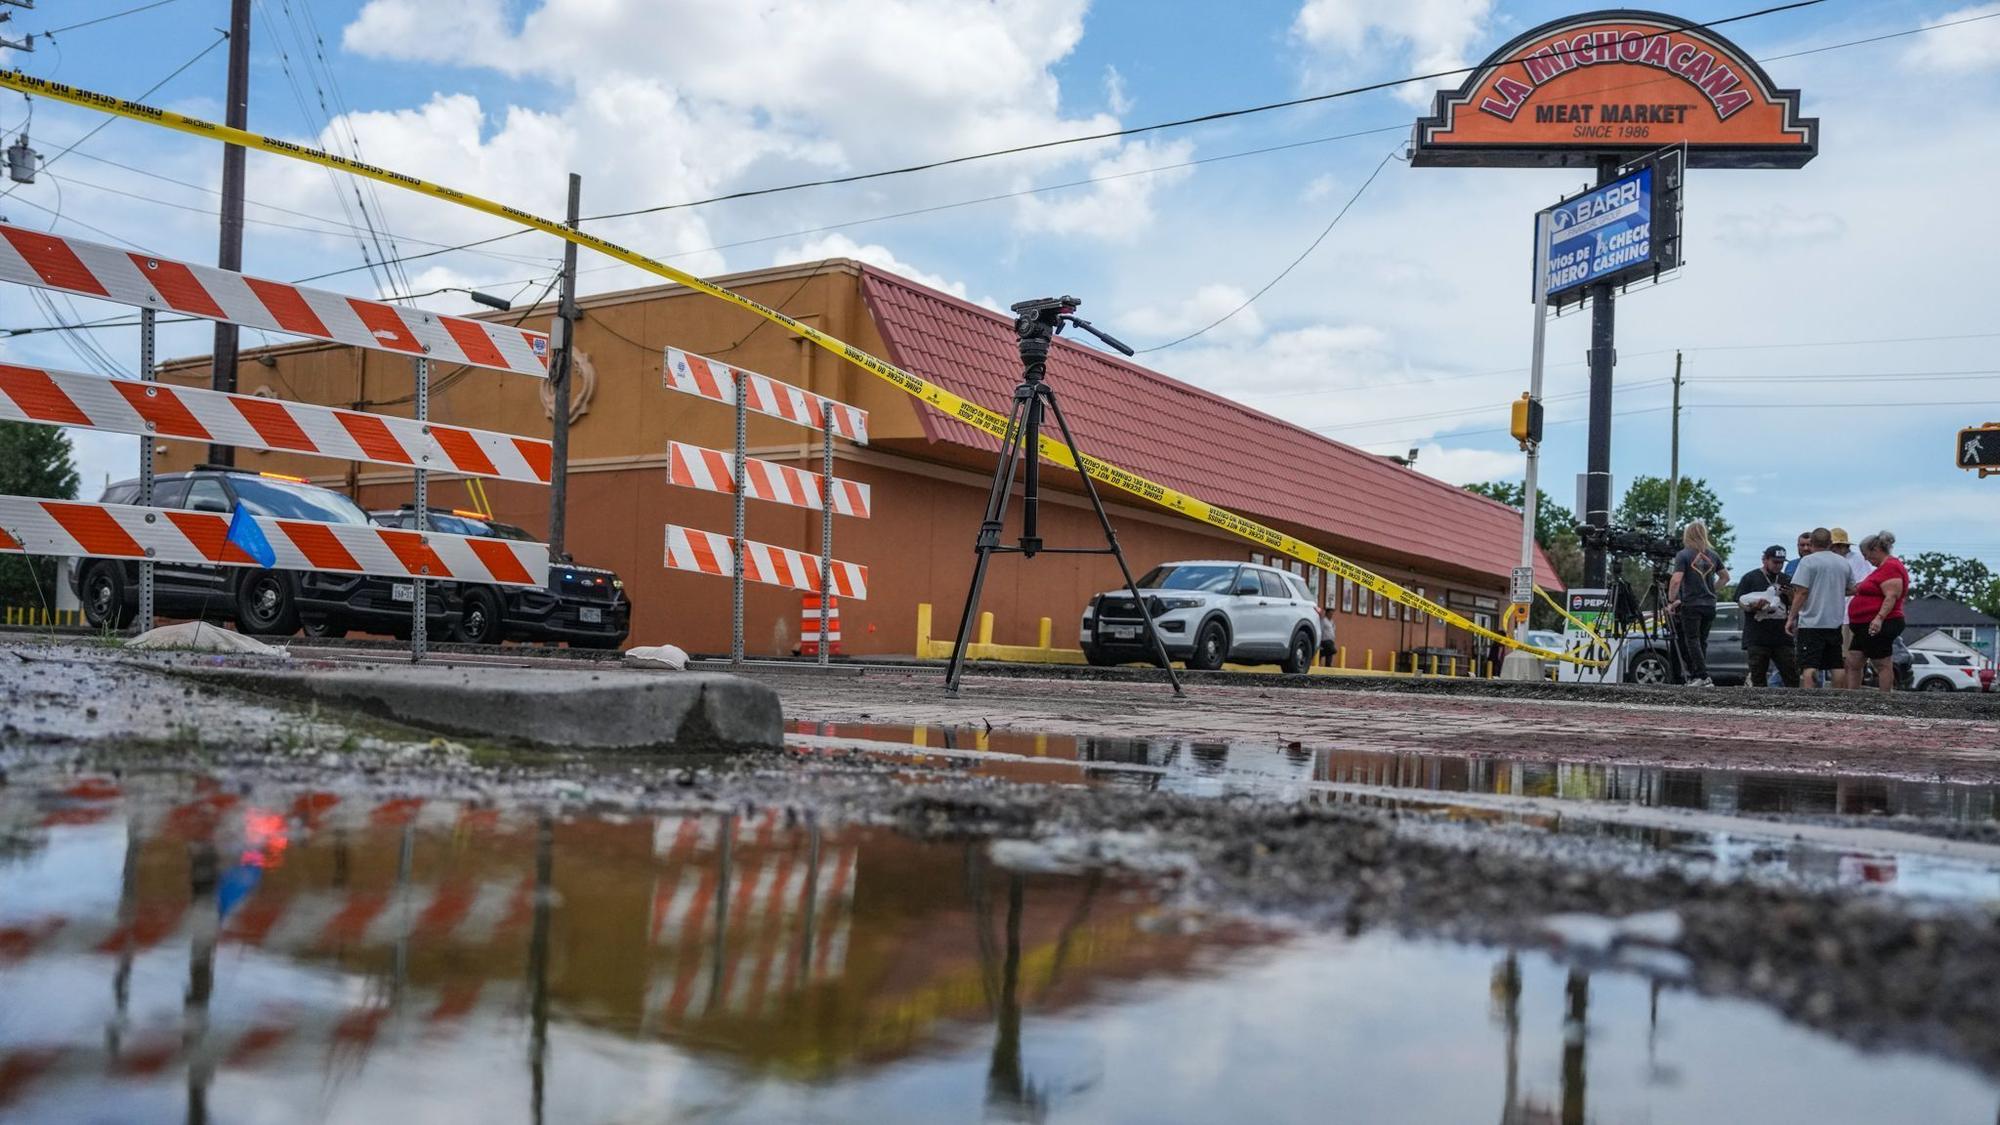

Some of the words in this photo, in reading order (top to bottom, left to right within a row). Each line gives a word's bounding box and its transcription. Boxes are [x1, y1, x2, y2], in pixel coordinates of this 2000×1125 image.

[1480, 76, 1534, 121] LA
[1522, 30, 1752, 120] MICHOACANA
[1536, 104, 1594, 123] MEAT
[1573, 126, 1613, 138] SINCE
[1618, 126, 1649, 138] 1986
[1577, 178, 1640, 223] BARRI
[1609, 223, 1650, 250] CHECK
[1576, 246, 1590, 262] DE
[1593, 241, 1650, 272] CASHING
[1547, 261, 1588, 290] INERO
[1079, 456, 1100, 470] CRUZA
[1097, 471, 1109, 480] NOT
[1121, 480, 1141, 493] SCENE
[1143, 488, 1163, 501] CRIME
[1584, 598, 1612, 607] PEP
